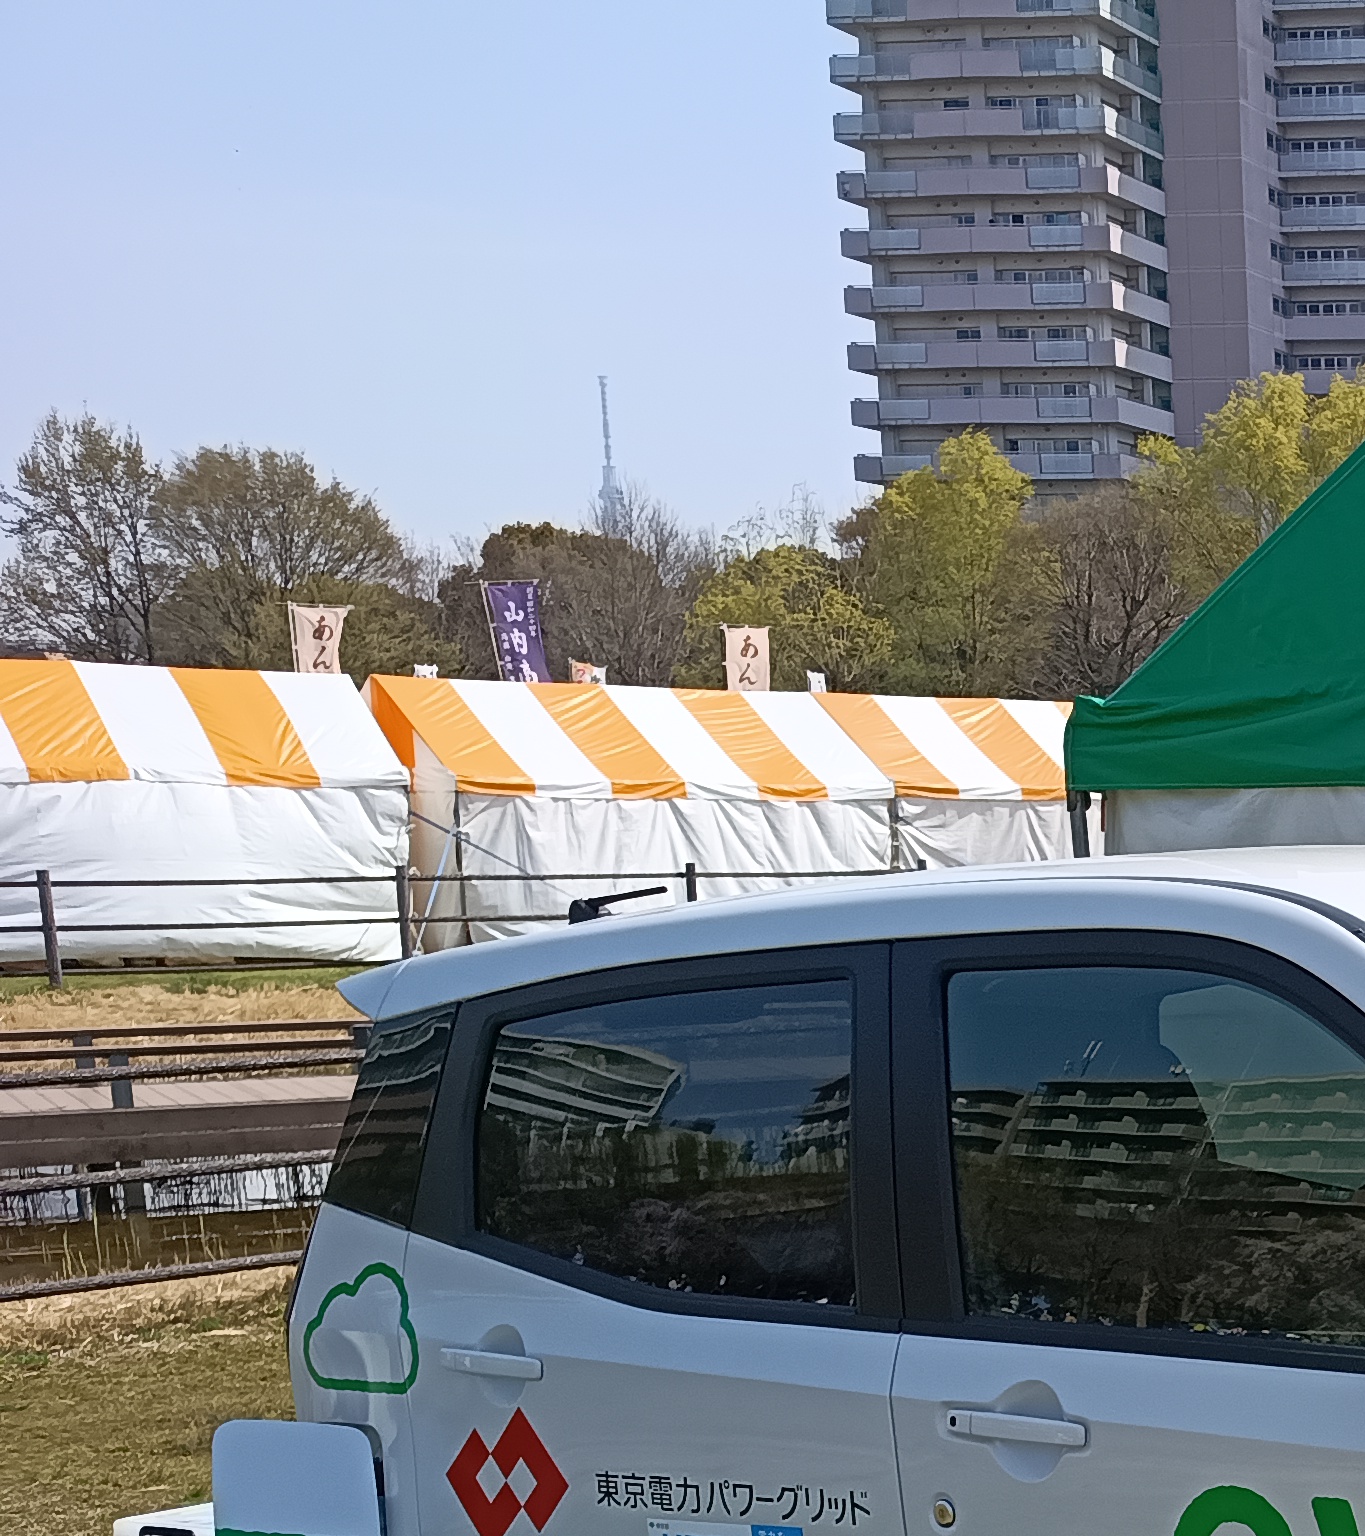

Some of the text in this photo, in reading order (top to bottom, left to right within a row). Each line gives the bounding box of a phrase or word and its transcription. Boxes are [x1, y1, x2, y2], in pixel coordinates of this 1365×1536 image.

[594, 1471, 871, 1527] 東京電力パワーグリッド
